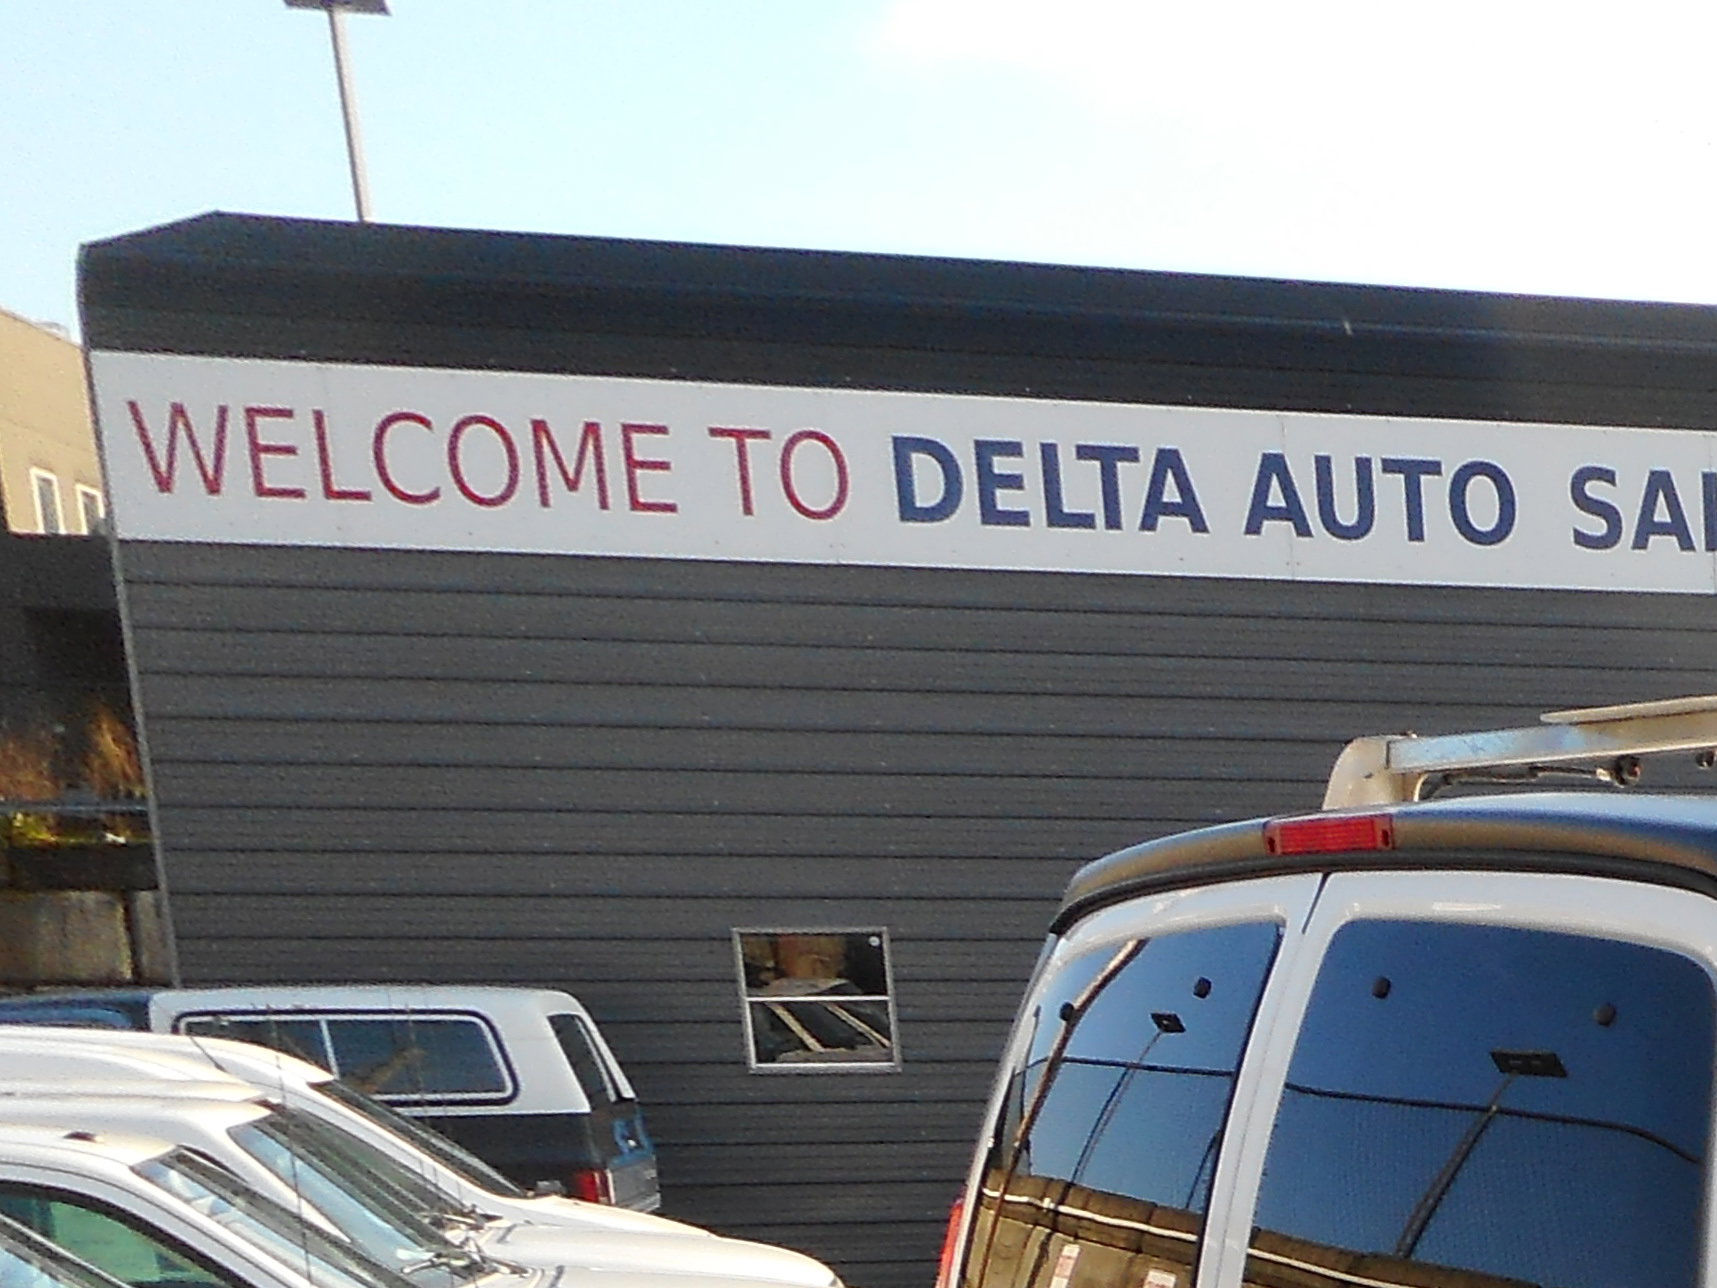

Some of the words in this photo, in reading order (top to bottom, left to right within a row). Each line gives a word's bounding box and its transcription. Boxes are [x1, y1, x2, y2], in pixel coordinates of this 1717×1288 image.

[127, 401, 679, 515] WELCOME
[709, 426, 850, 521] TO
[893, 436, 1209, 535] DELTA
[1244, 451, 1518, 546] AUTO
